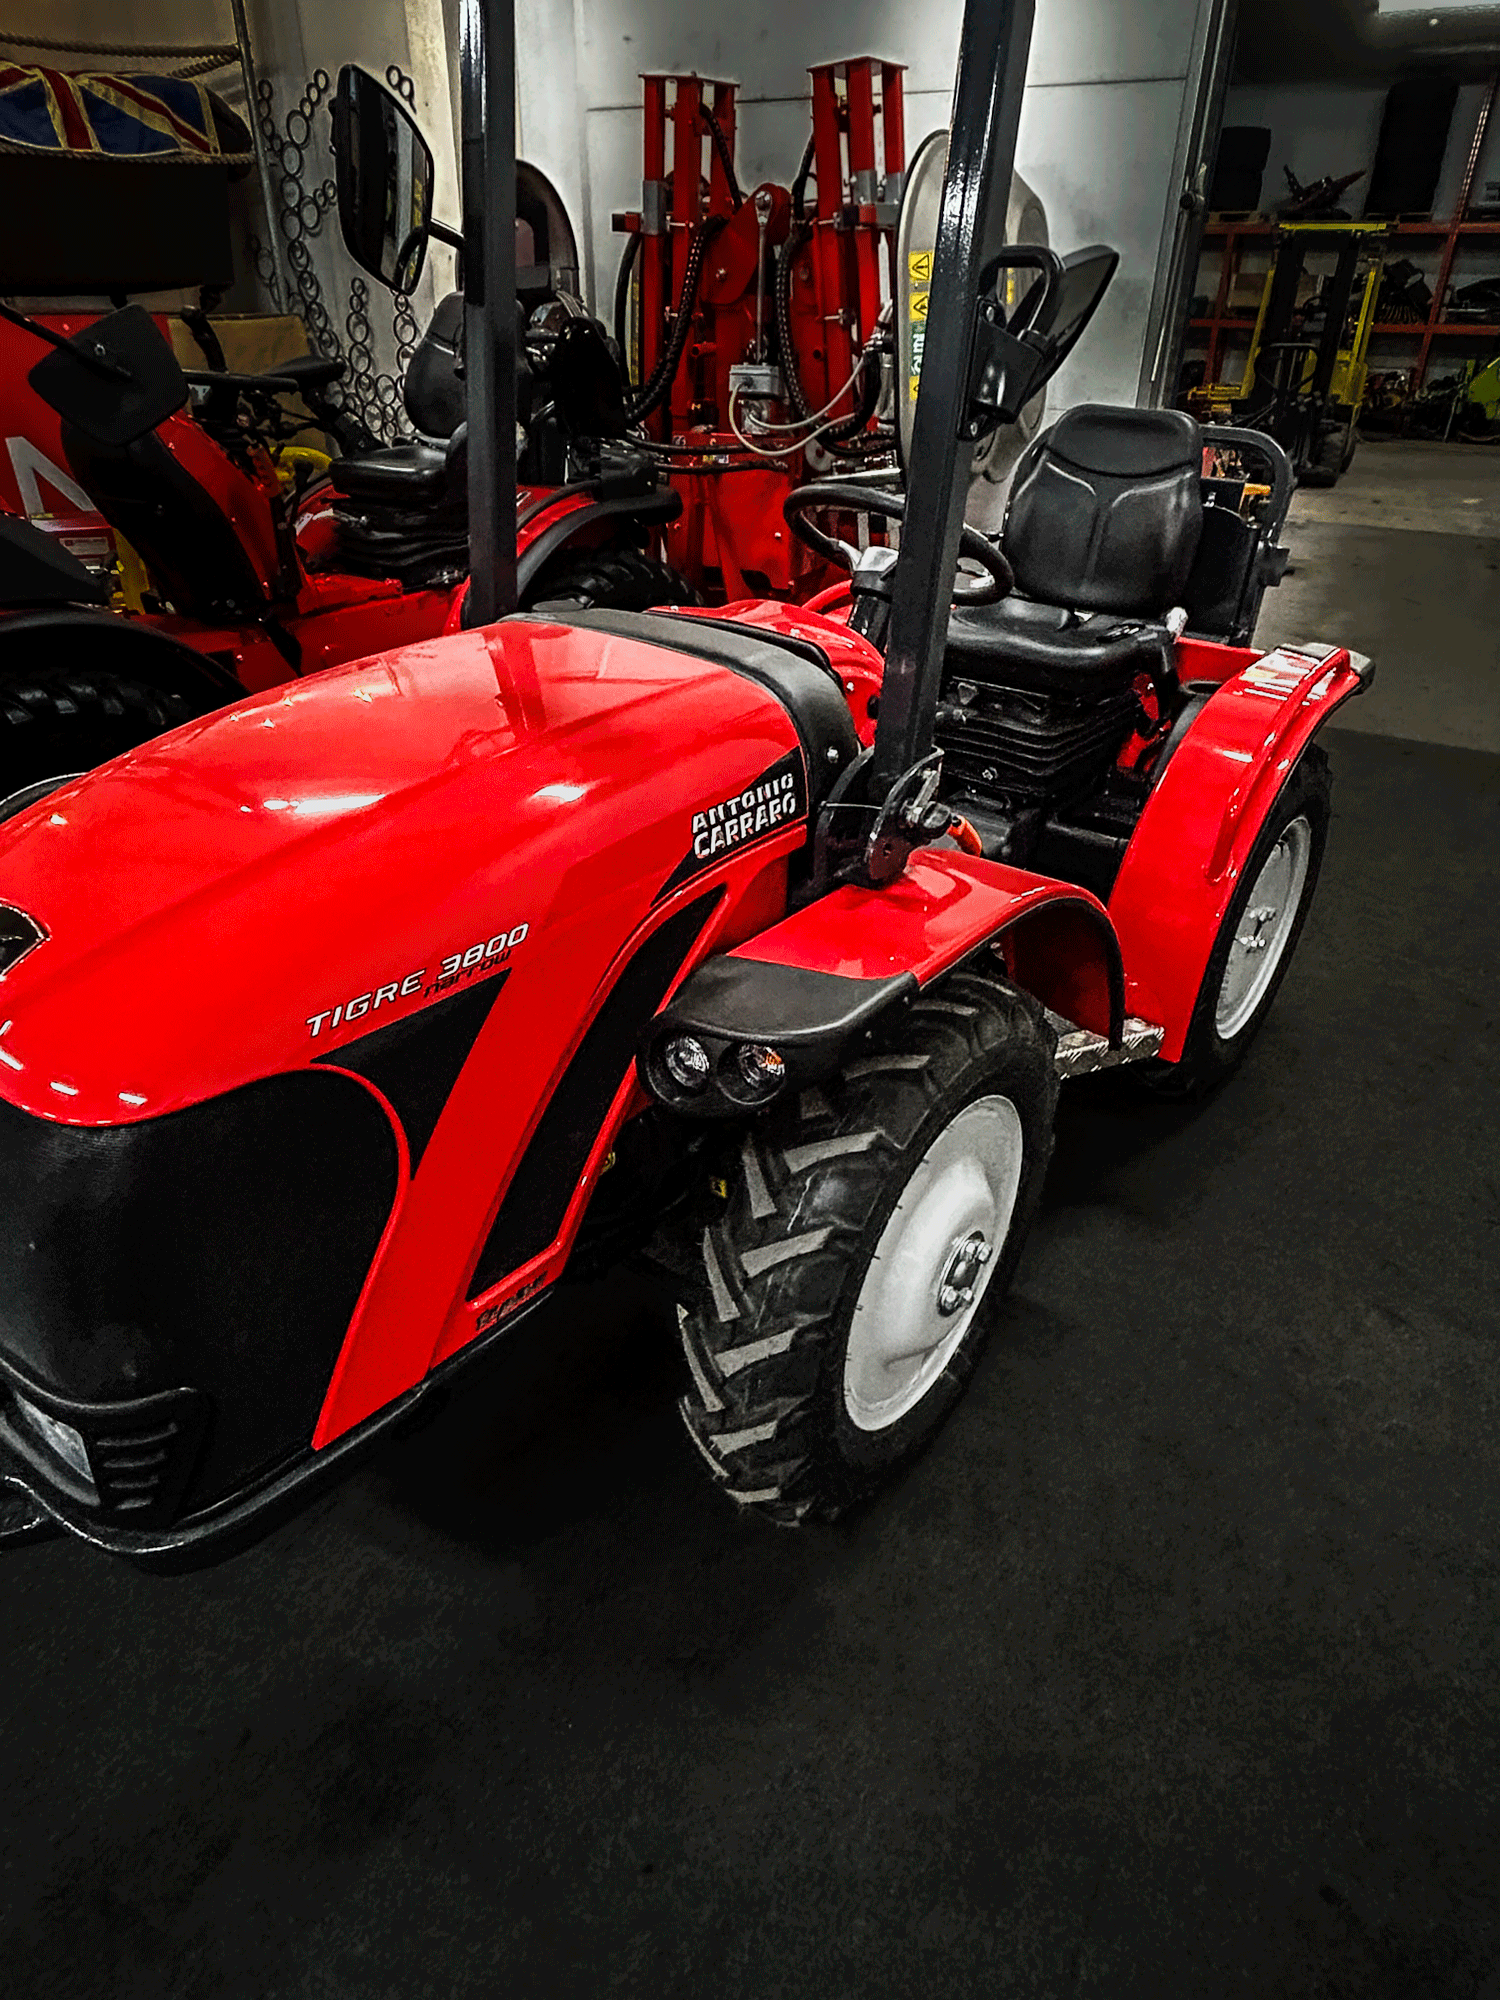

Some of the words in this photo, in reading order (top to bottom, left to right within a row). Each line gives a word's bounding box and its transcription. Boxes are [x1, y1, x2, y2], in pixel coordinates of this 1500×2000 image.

[692, 772, 794, 834] ANTONIO
[694, 791, 796, 859] CARRARO
[306, 968, 427, 1038] TIGRE
[437, 922, 530, 981] 3800
[423, 948, 512, 999] narrow
